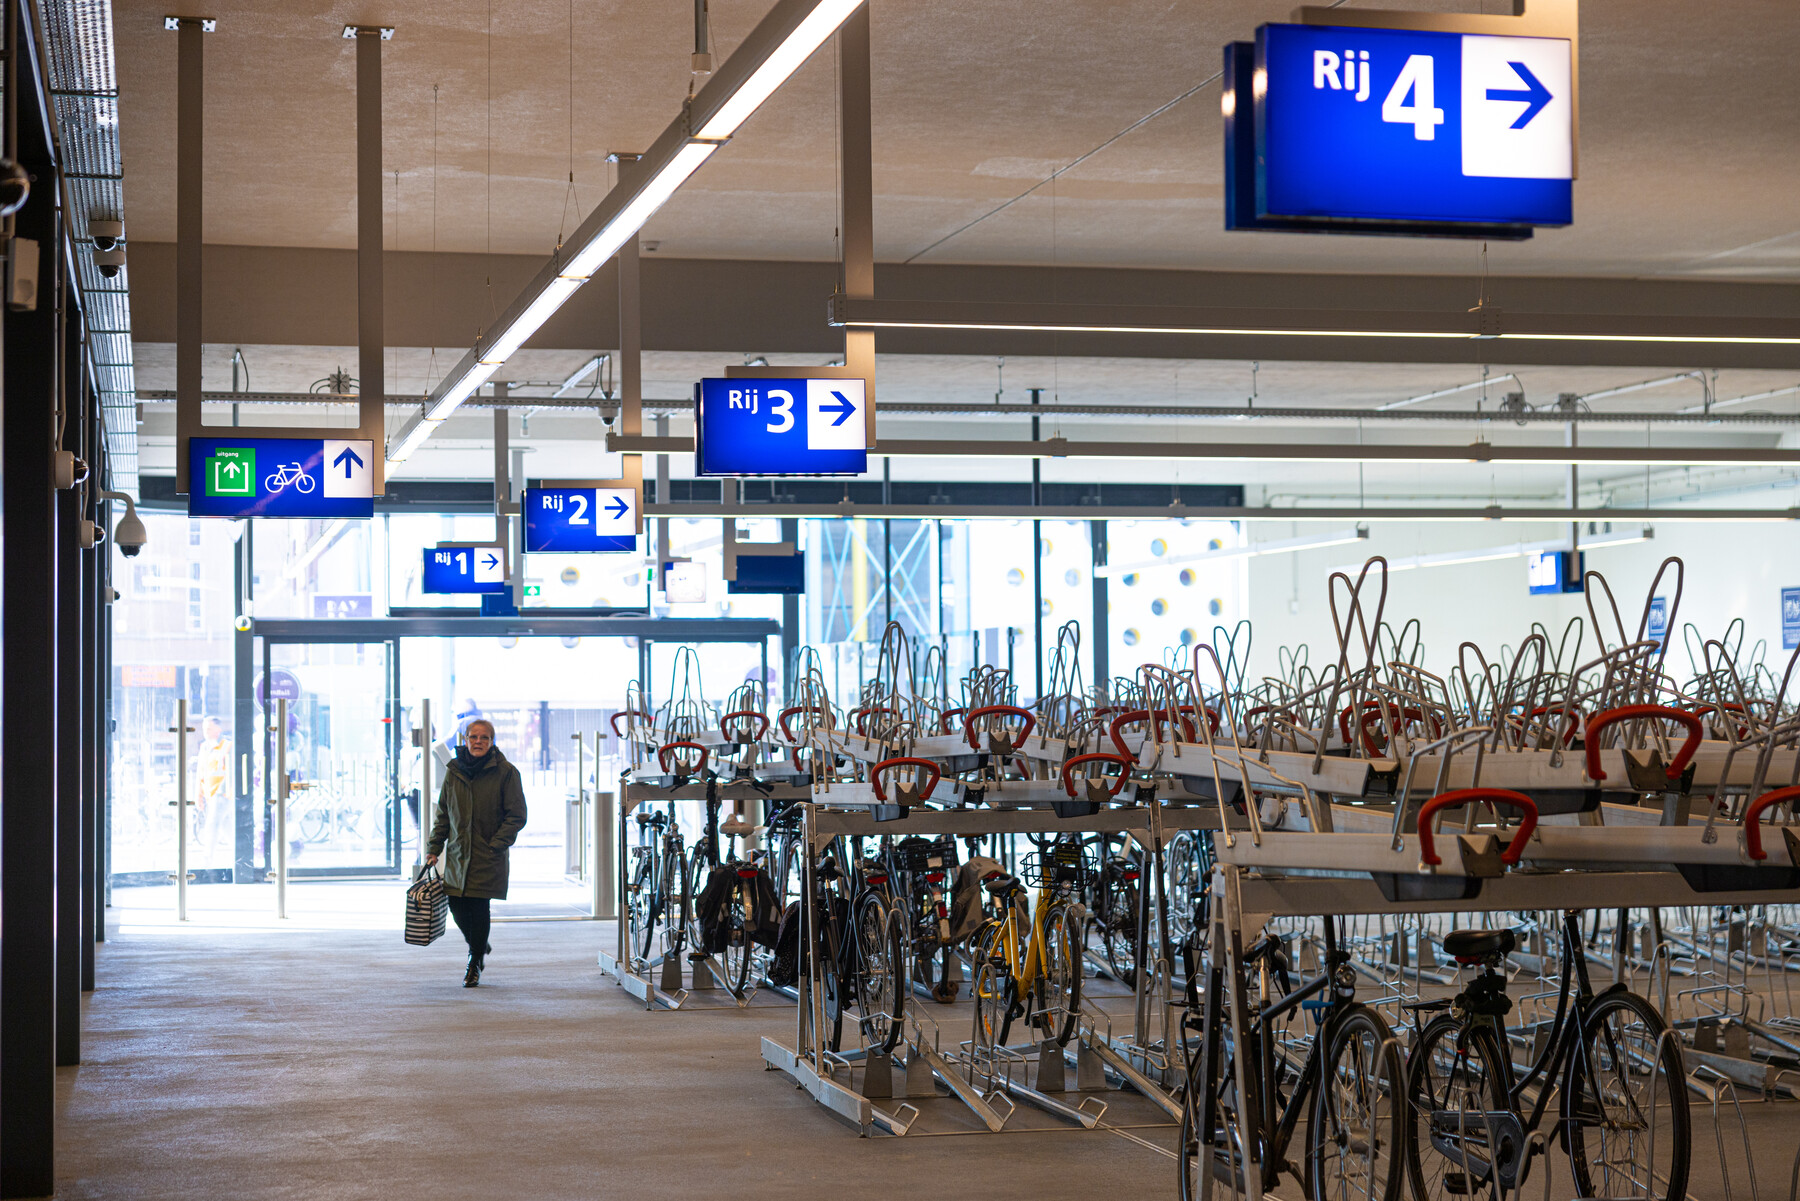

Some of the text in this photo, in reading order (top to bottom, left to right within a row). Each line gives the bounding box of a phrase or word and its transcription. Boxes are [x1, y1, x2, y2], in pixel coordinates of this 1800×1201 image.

[1313, 49, 1444, 141] Rij 4
[728, 389, 795, 434] Rij 3
[542, 494, 589, 525] Rij 2
[434, 552, 468, 575] Rij 1
